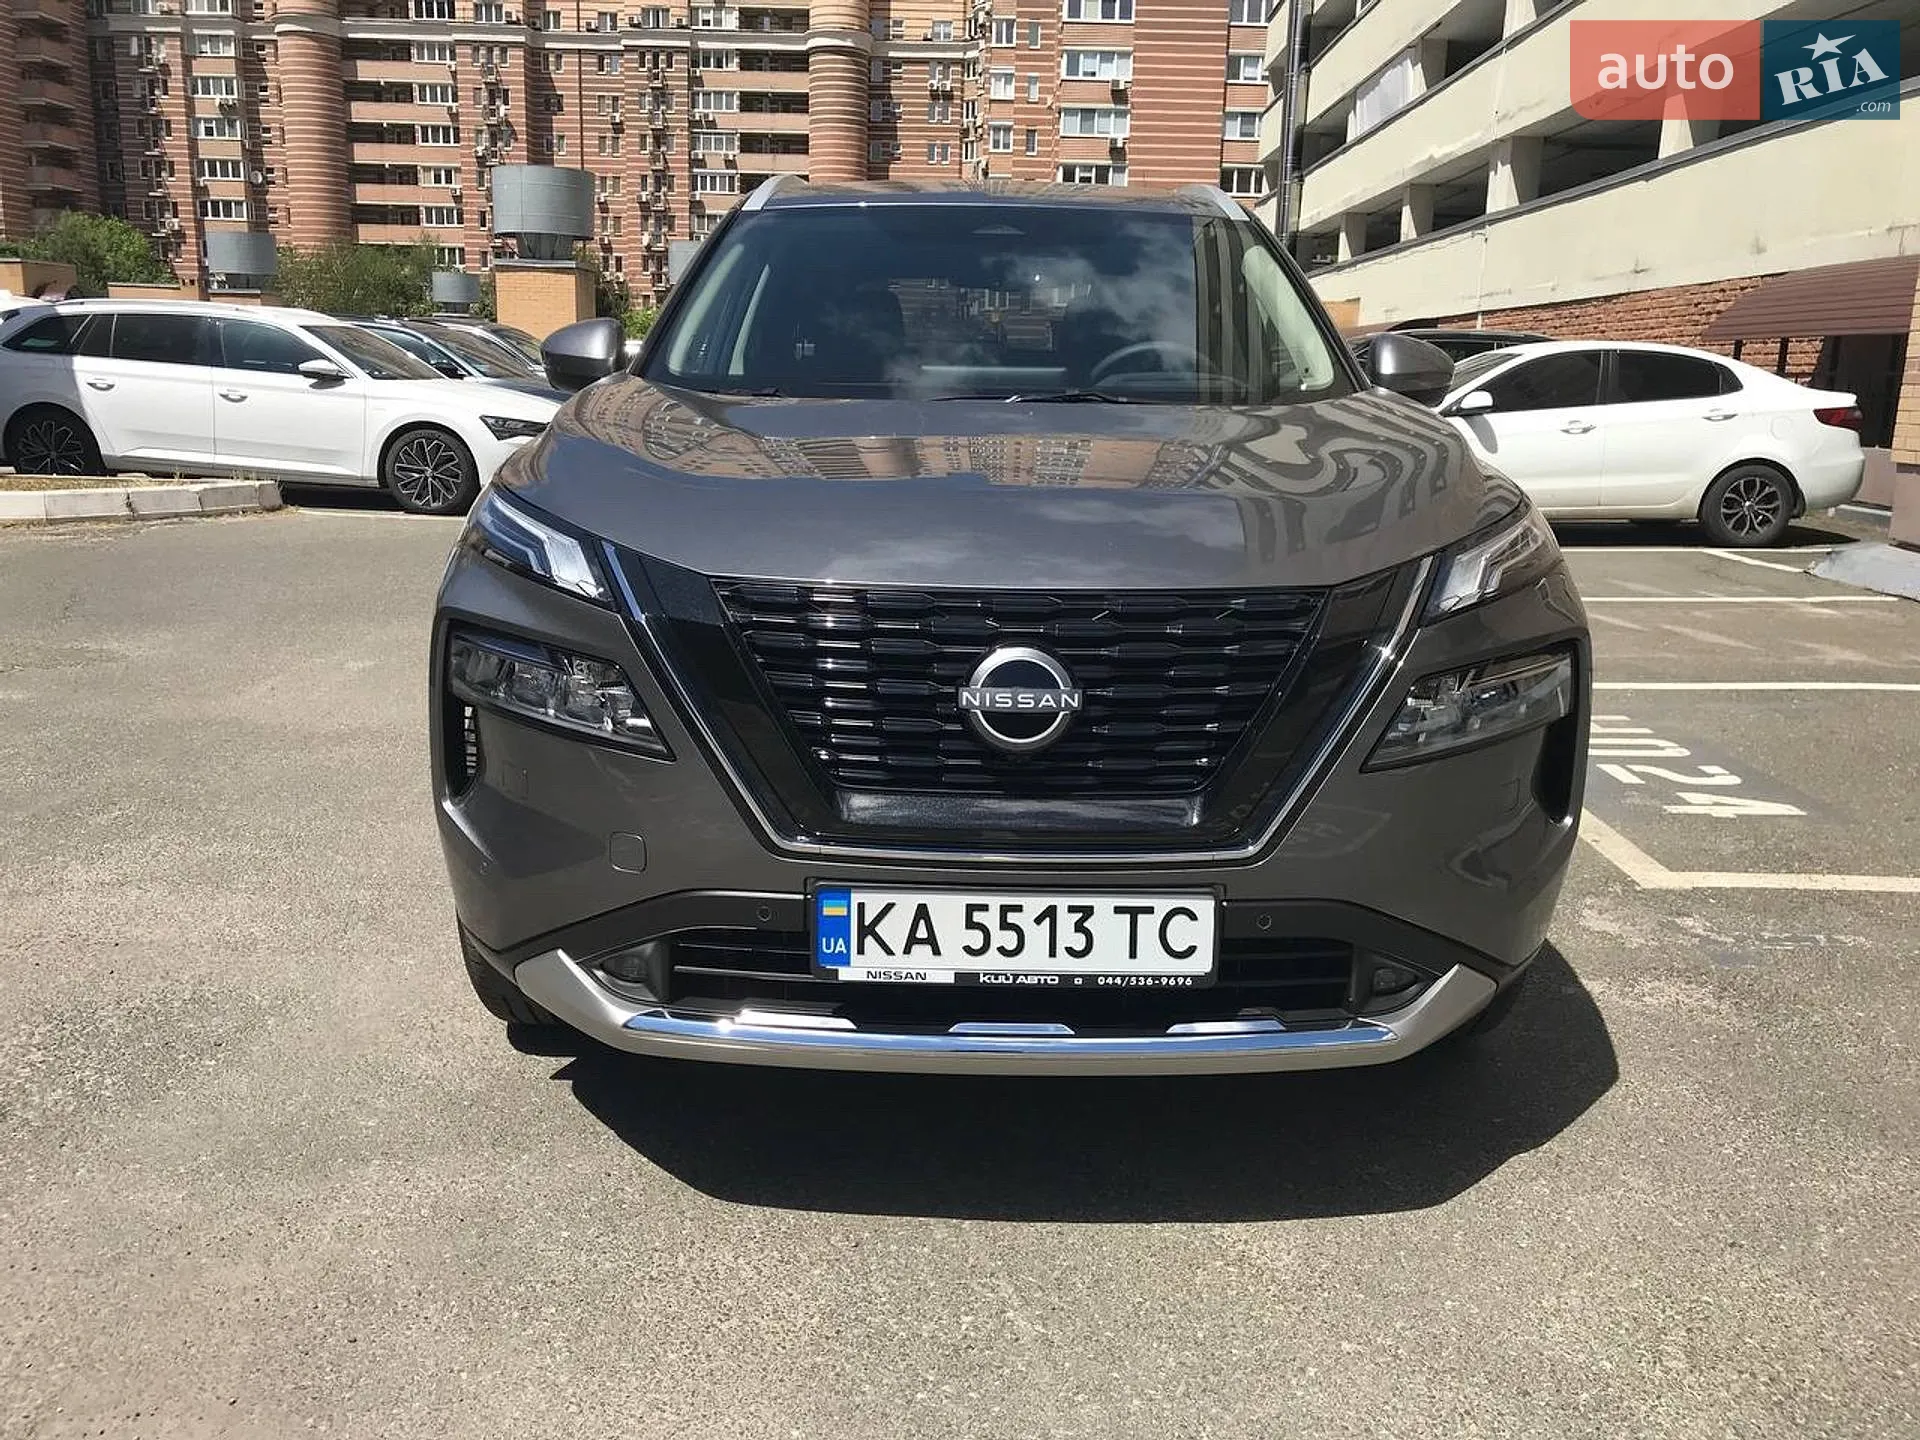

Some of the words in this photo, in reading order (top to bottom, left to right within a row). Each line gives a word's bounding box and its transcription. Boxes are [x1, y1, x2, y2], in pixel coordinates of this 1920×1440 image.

[961, 691, 1079, 708] NISSAN
[855, 901, 942, 957] KA
[961, 903, 1095, 959] 5513
[1113, 906, 1199, 961] TC
[821, 936, 848, 955] UA
[865, 970, 928, 982] NISSAN
[1015, 975, 1060, 985] АВТО
[1097, 976, 1194, 987] 044/536-9696
